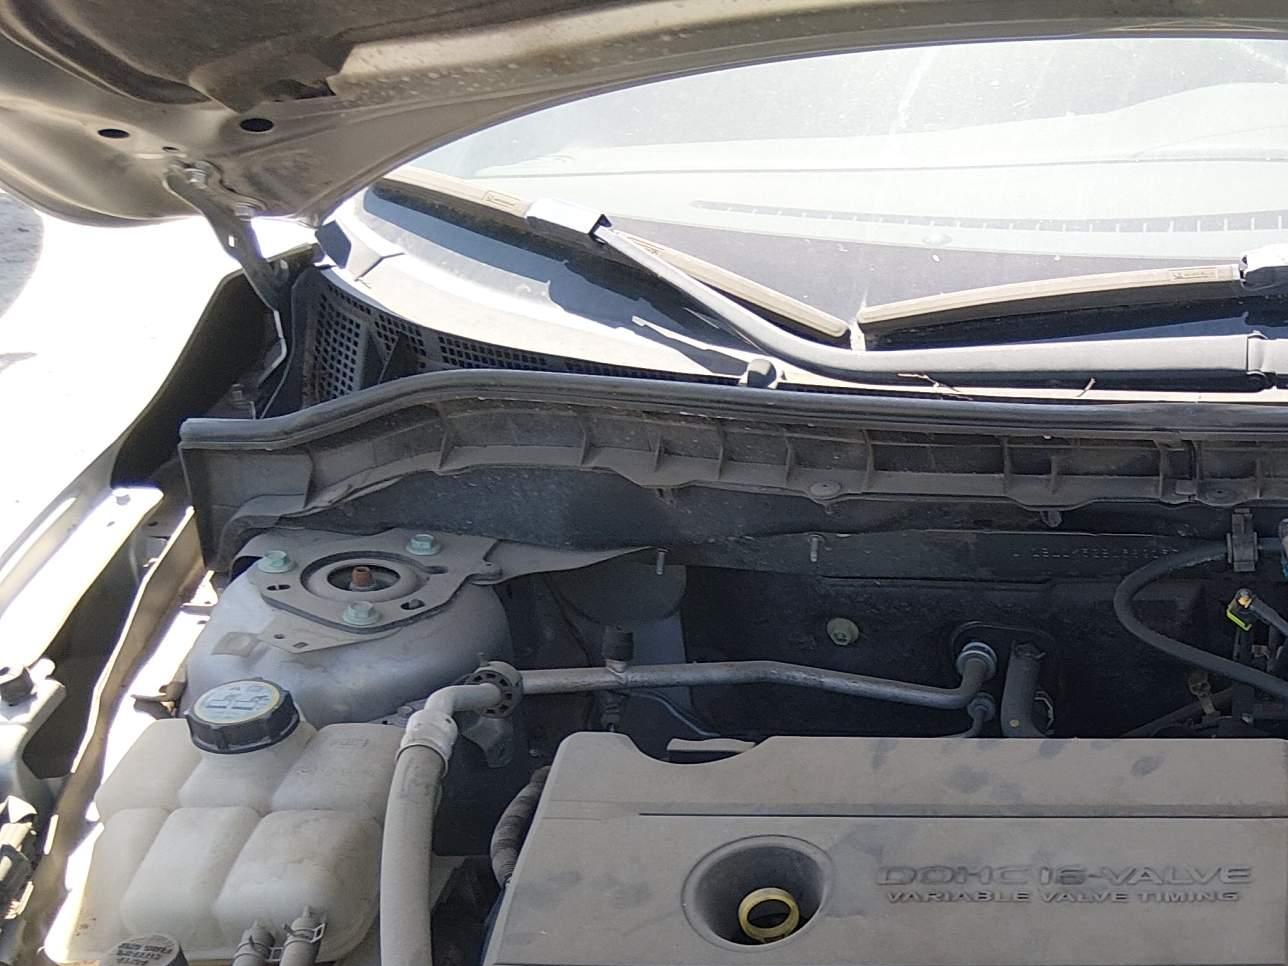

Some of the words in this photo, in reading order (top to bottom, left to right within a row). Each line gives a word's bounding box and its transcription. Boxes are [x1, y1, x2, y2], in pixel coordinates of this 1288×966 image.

[877, 865, 1032, 885] DOHC
[1040, 865, 1251, 885] 16-VALVE
[887, 891, 1031, 903] VARIABLE
[1041, 891, 1129, 903] VALVE
[1139, 891, 1240, 903] TIMING
